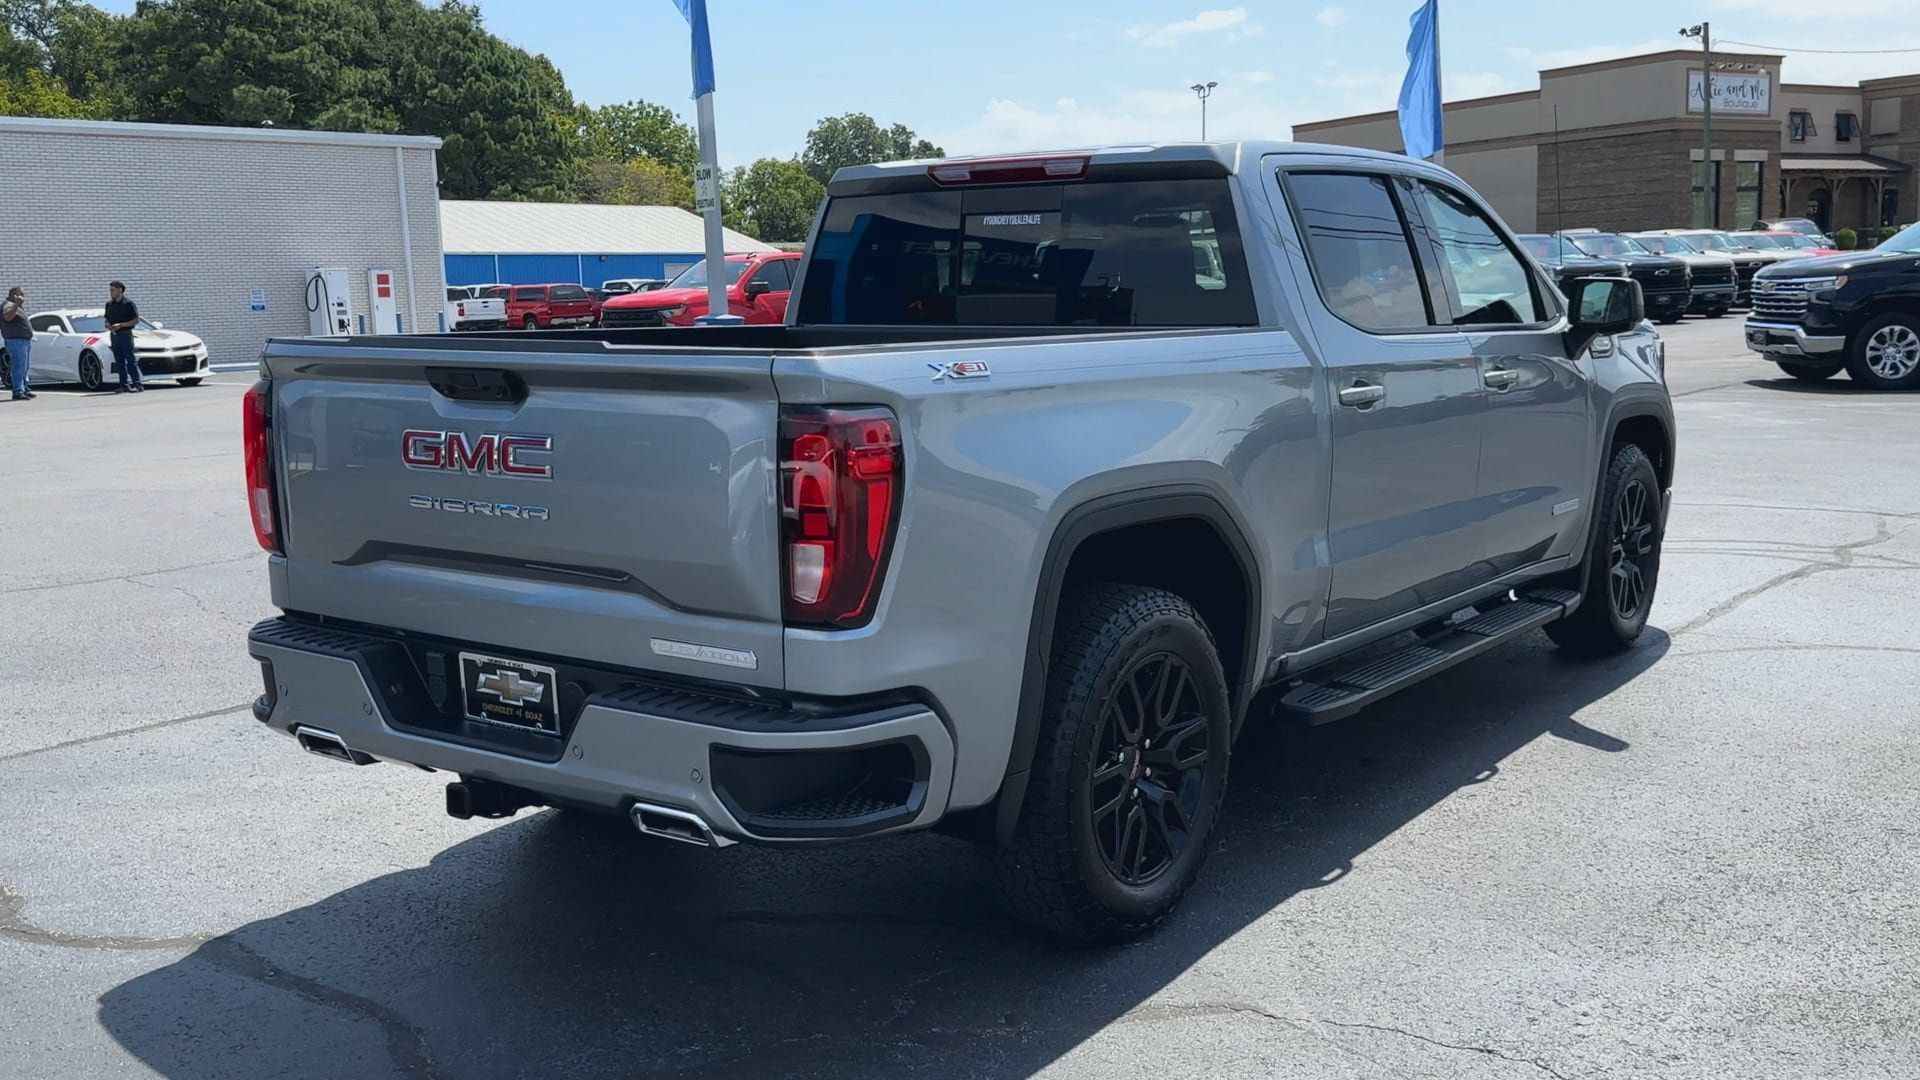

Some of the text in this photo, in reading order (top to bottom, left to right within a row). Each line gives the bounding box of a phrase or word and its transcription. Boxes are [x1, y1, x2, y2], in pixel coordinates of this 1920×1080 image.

[1727, 80, 1748, 98] and
[1750, 80, 1765, 100] Me
[1723, 98, 1759, 108] Boutique
[696, 168, 711, 181] SLOW
[402, 429, 552, 480] GMC
[409, 495, 550, 520] SIERRA
[525, 711, 544, 722] BOAZ
